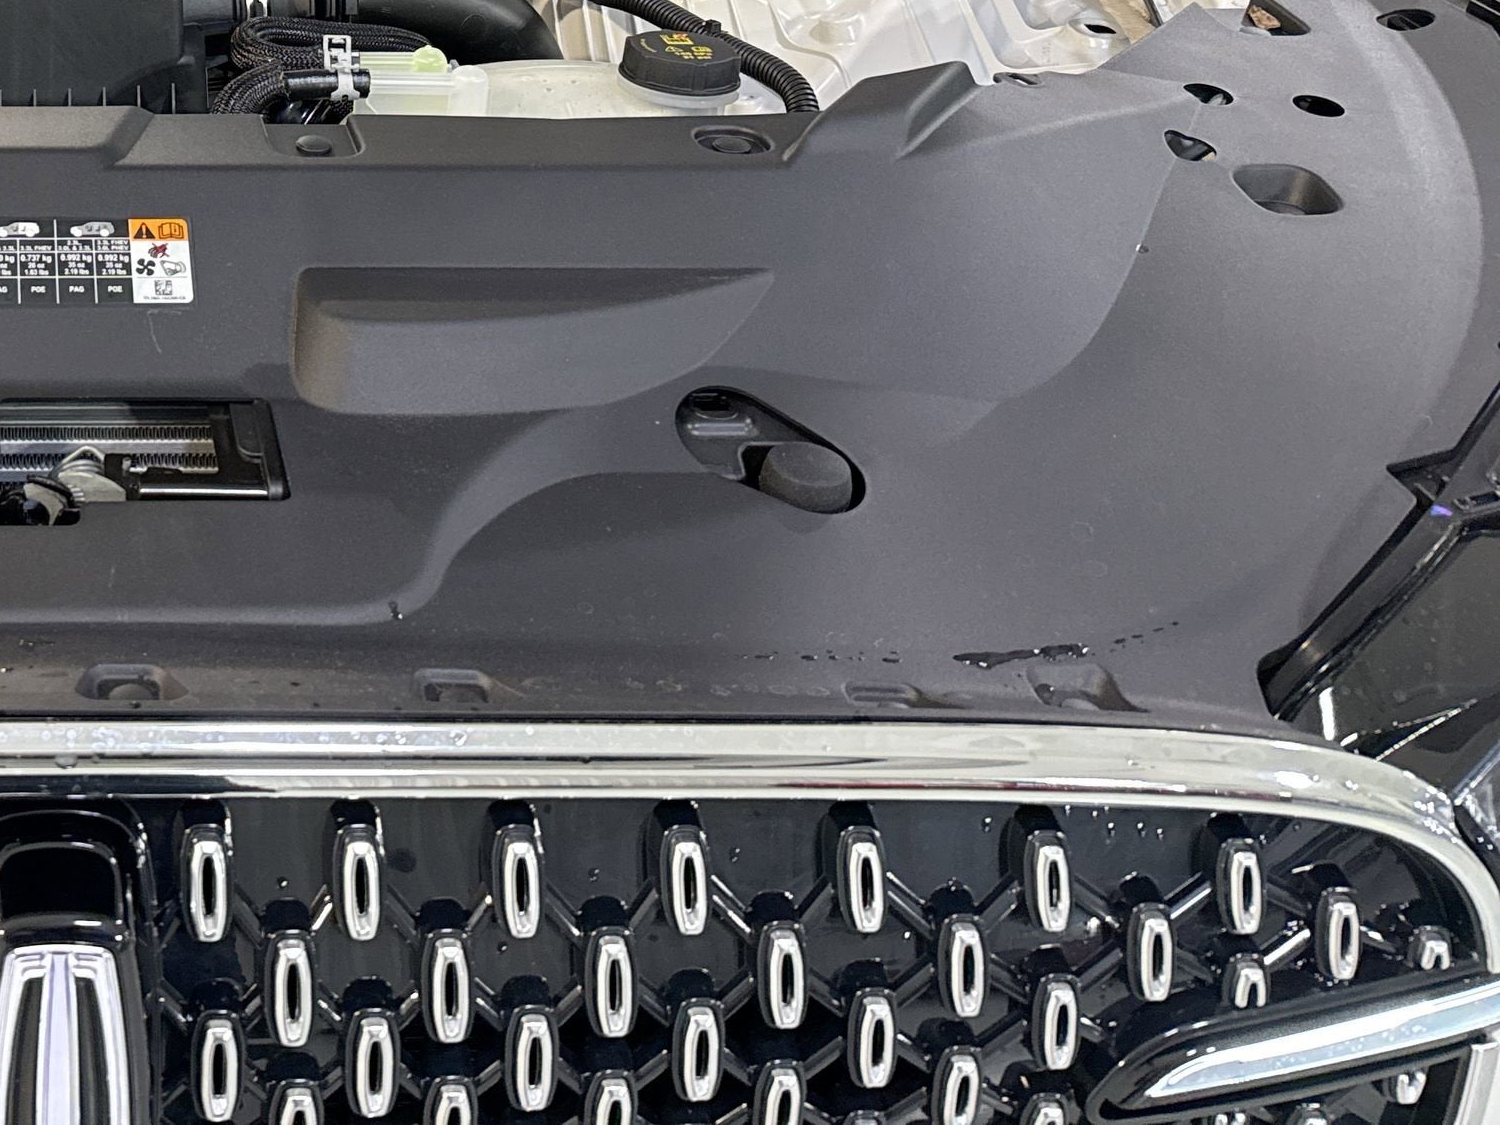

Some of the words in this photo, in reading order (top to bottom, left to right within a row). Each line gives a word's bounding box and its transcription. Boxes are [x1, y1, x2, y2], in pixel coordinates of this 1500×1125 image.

[5, 254, 15, 263] kg
[42, 254, 52, 263] kg
[82, 254, 92, 263] kg
[119, 254, 129, 263] kg
